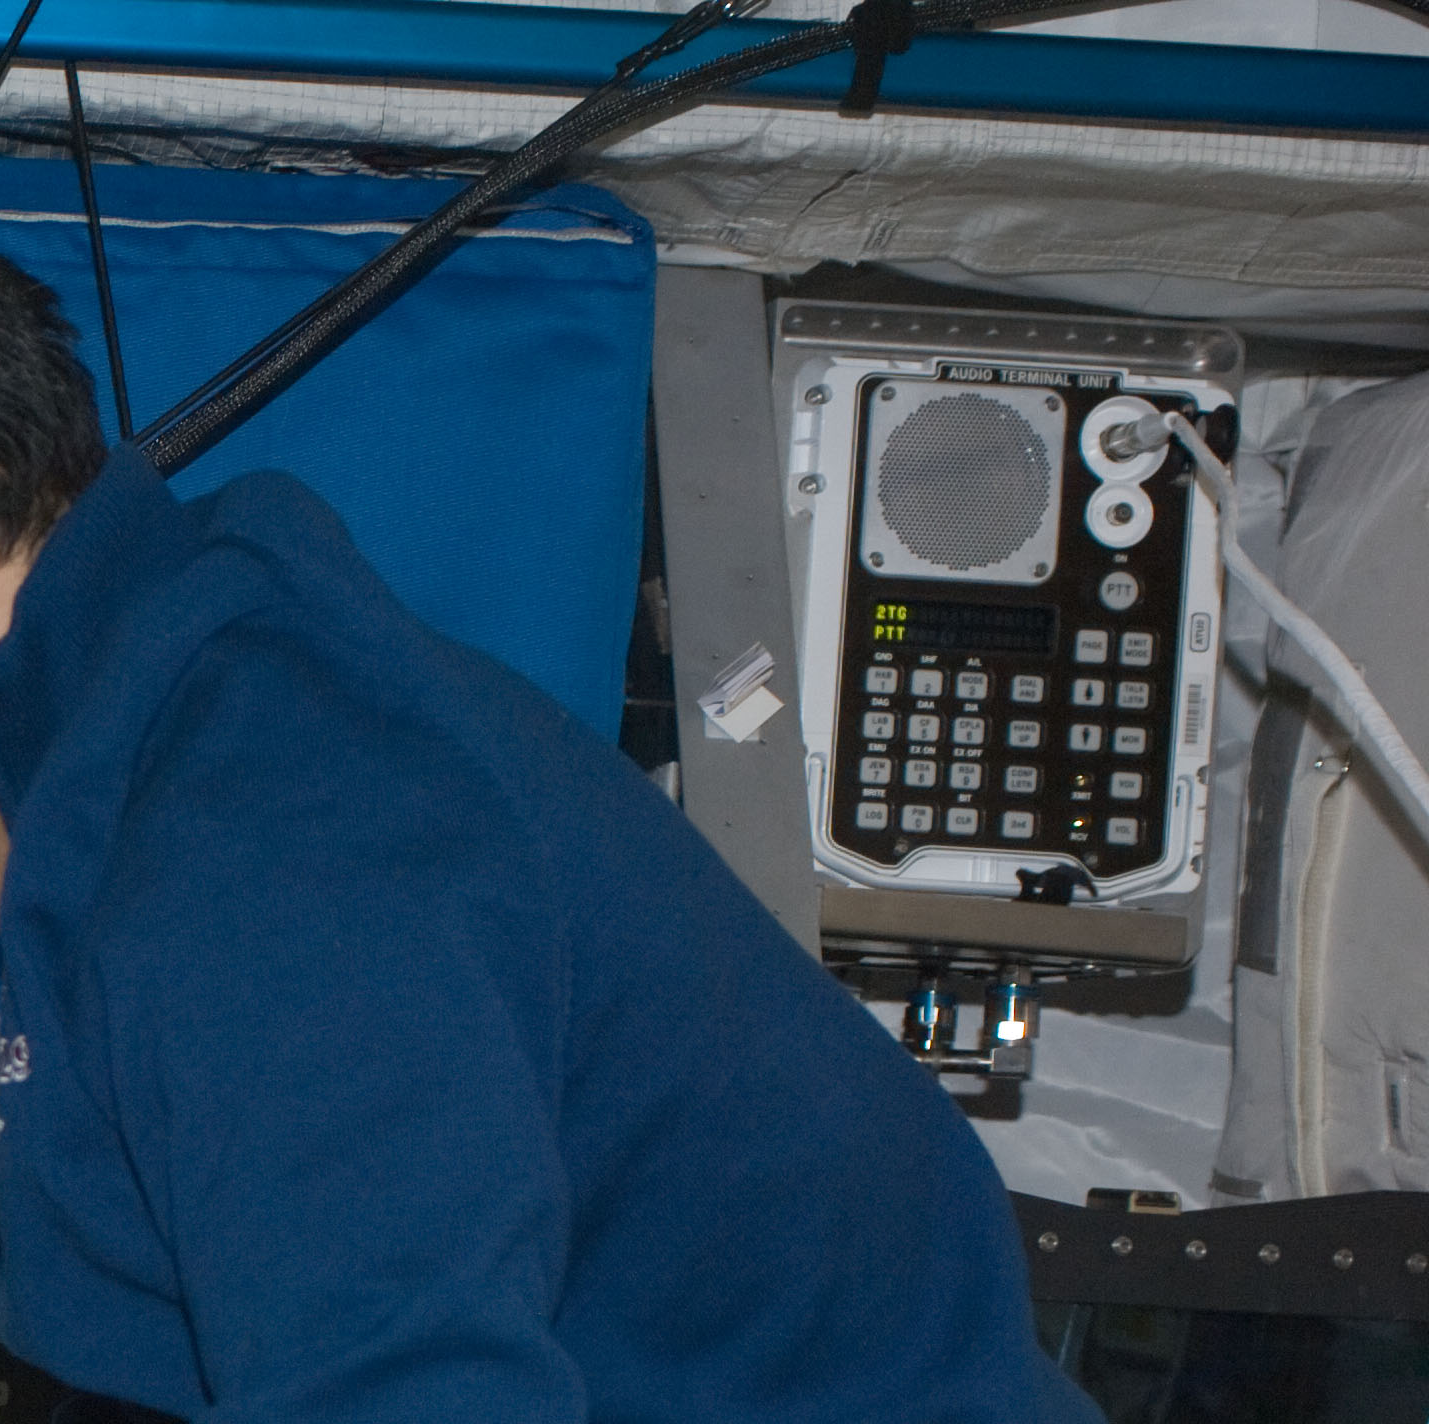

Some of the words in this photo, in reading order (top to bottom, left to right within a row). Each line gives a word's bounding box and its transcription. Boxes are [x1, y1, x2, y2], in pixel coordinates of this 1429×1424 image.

[948, 366, 993, 382] AUDIO
[999, 369, 1072, 386] TERMINAL
[1079, 375, 1112, 389] UNIT
[1106, 583, 1132, 596] PTT
[875, 604, 908, 621] 2TG
[874, 625, 905, 640] PTT
[880, 680, 886, 690] 1
[924, 683, 932, 693] 2
[871, 717, 889, 726] LAB
[876, 727, 883, 736] 4
[921, 729, 928, 739] 5
[966, 731, 973, 741] 6
[874, 771, 879, 780] 7
[963, 775, 971, 786] 9
